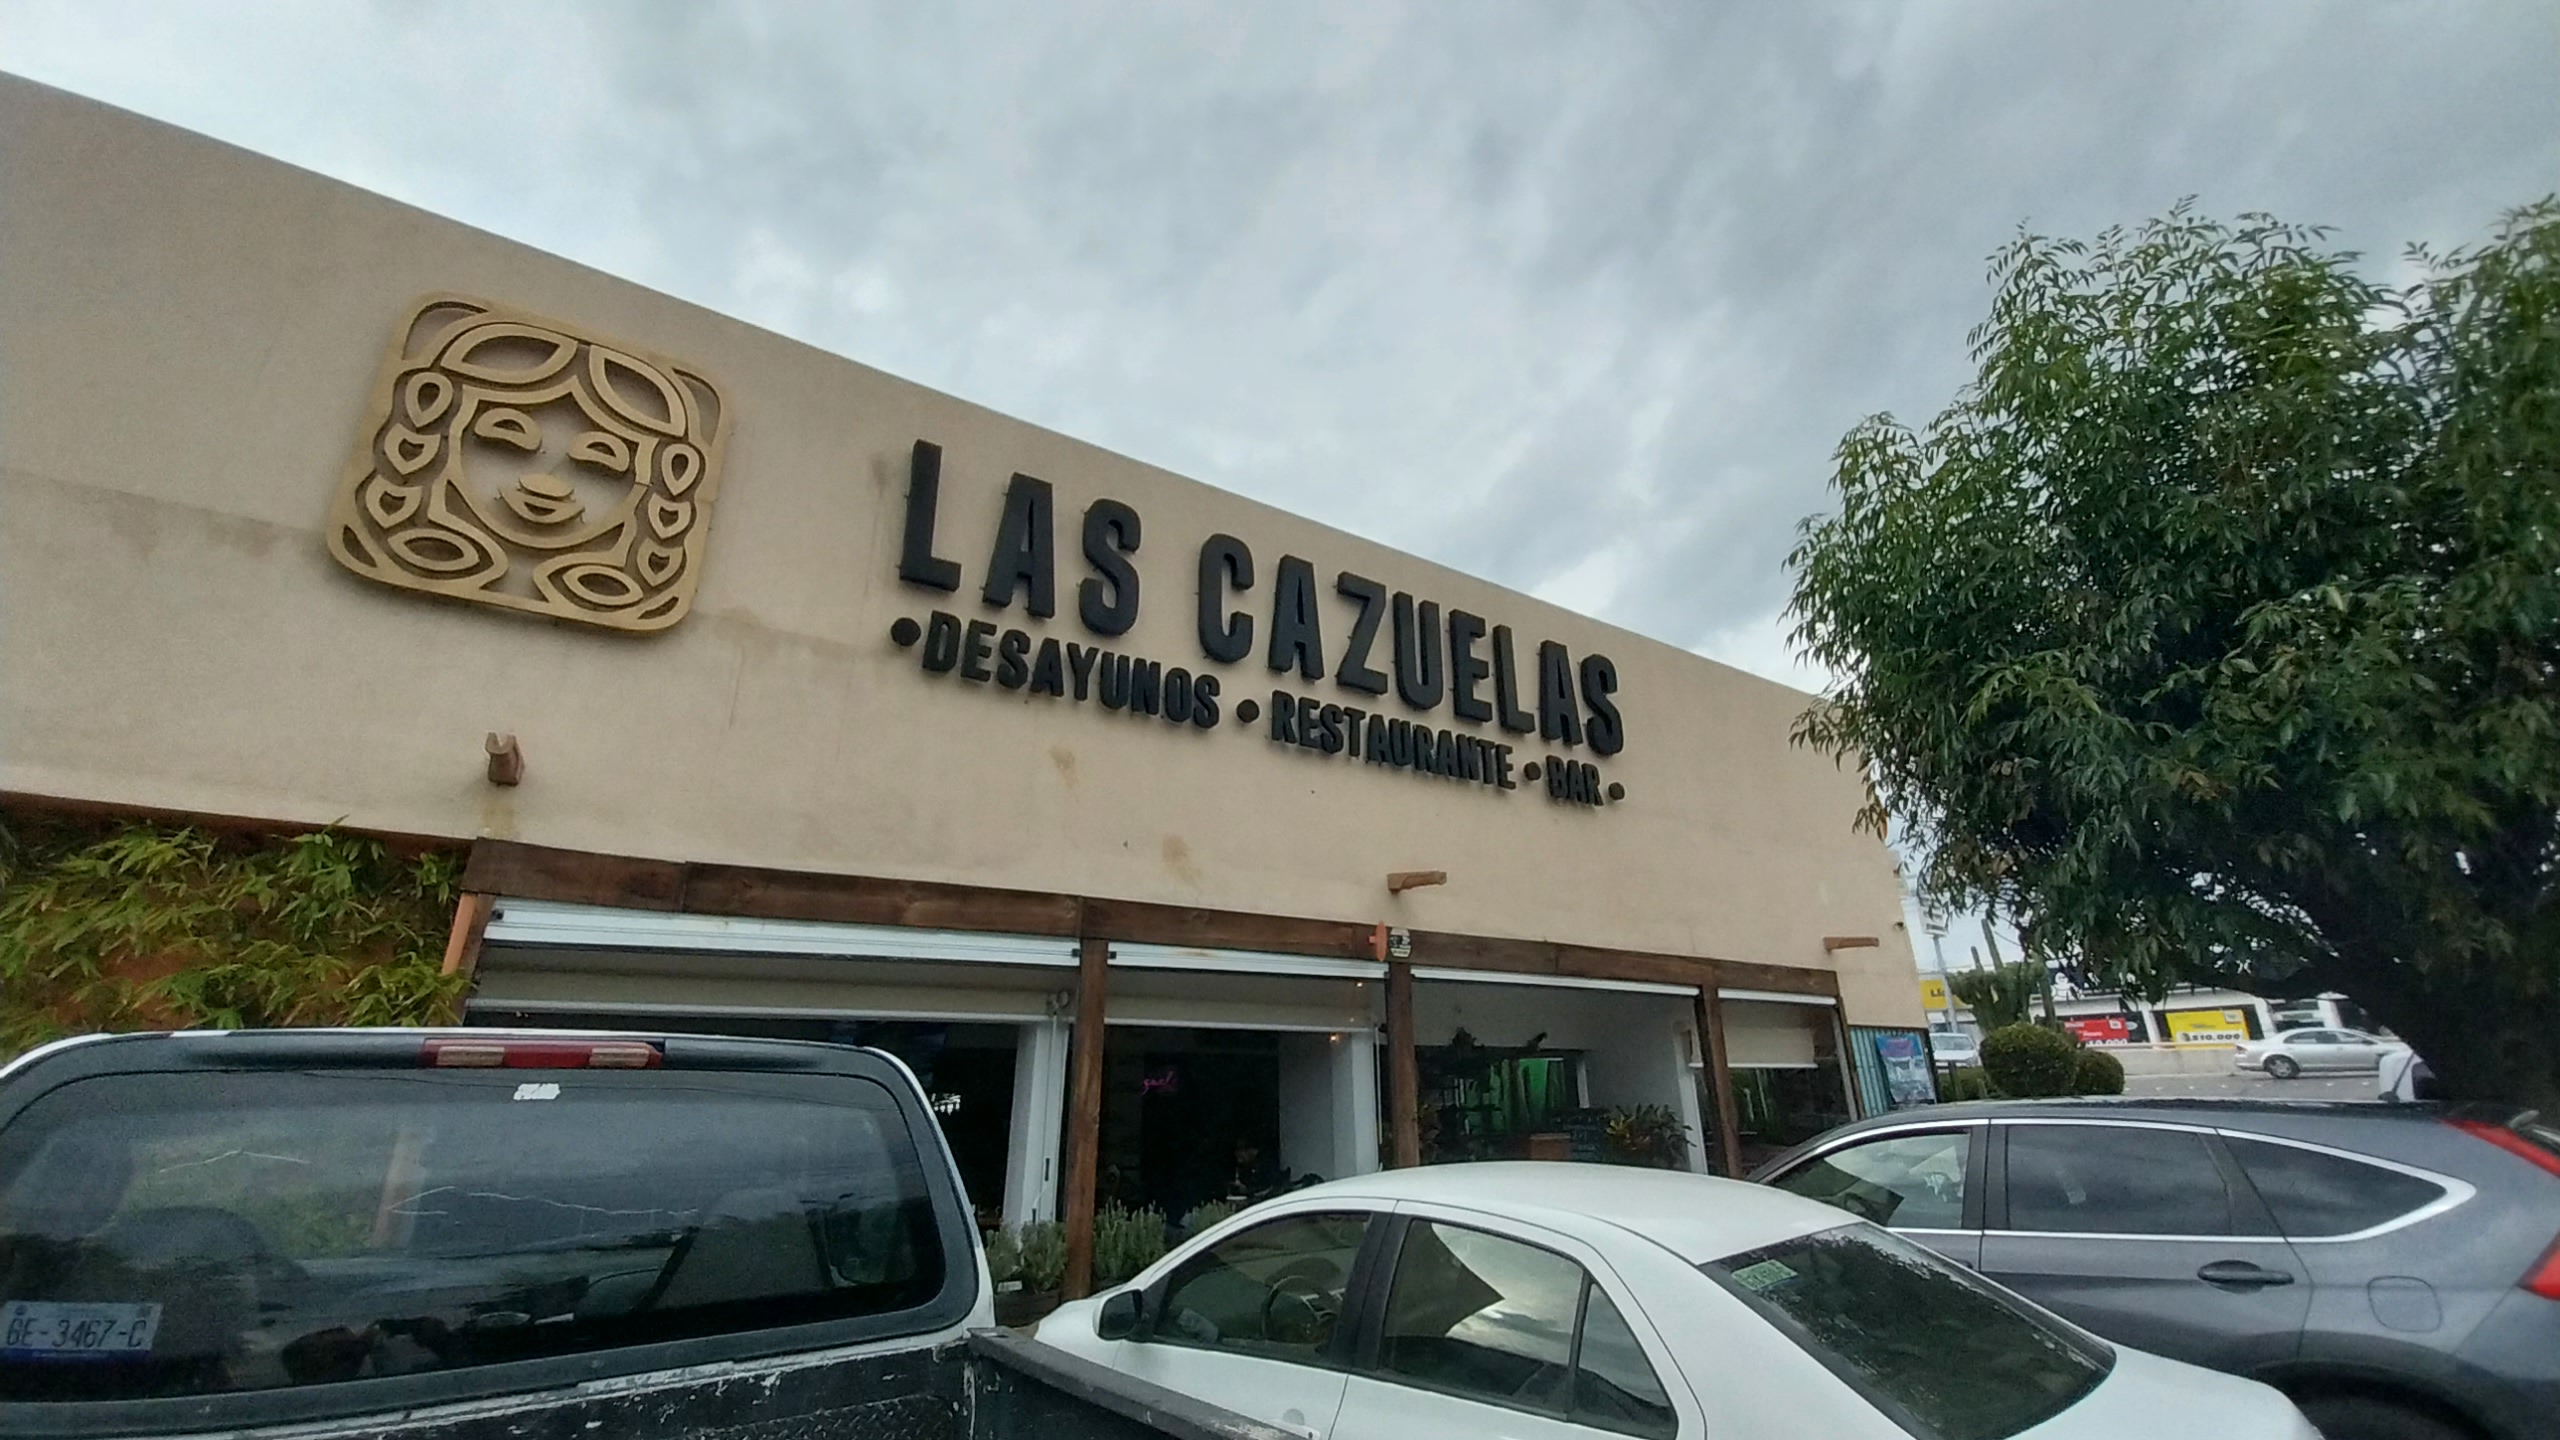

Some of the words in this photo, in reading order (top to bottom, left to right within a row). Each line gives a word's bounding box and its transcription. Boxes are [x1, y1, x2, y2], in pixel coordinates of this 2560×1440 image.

[899, 439, 1142, 636] LAS
[1198, 533, 1624, 756] CAZUELAS
[922, 610, 1221, 729] DESAYUNOS
[1271, 689, 1517, 791] RESTAURANTE
[1545, 754, 1604, 806] BAR
[6, 1317, 147, 1348] GE-3467-C
